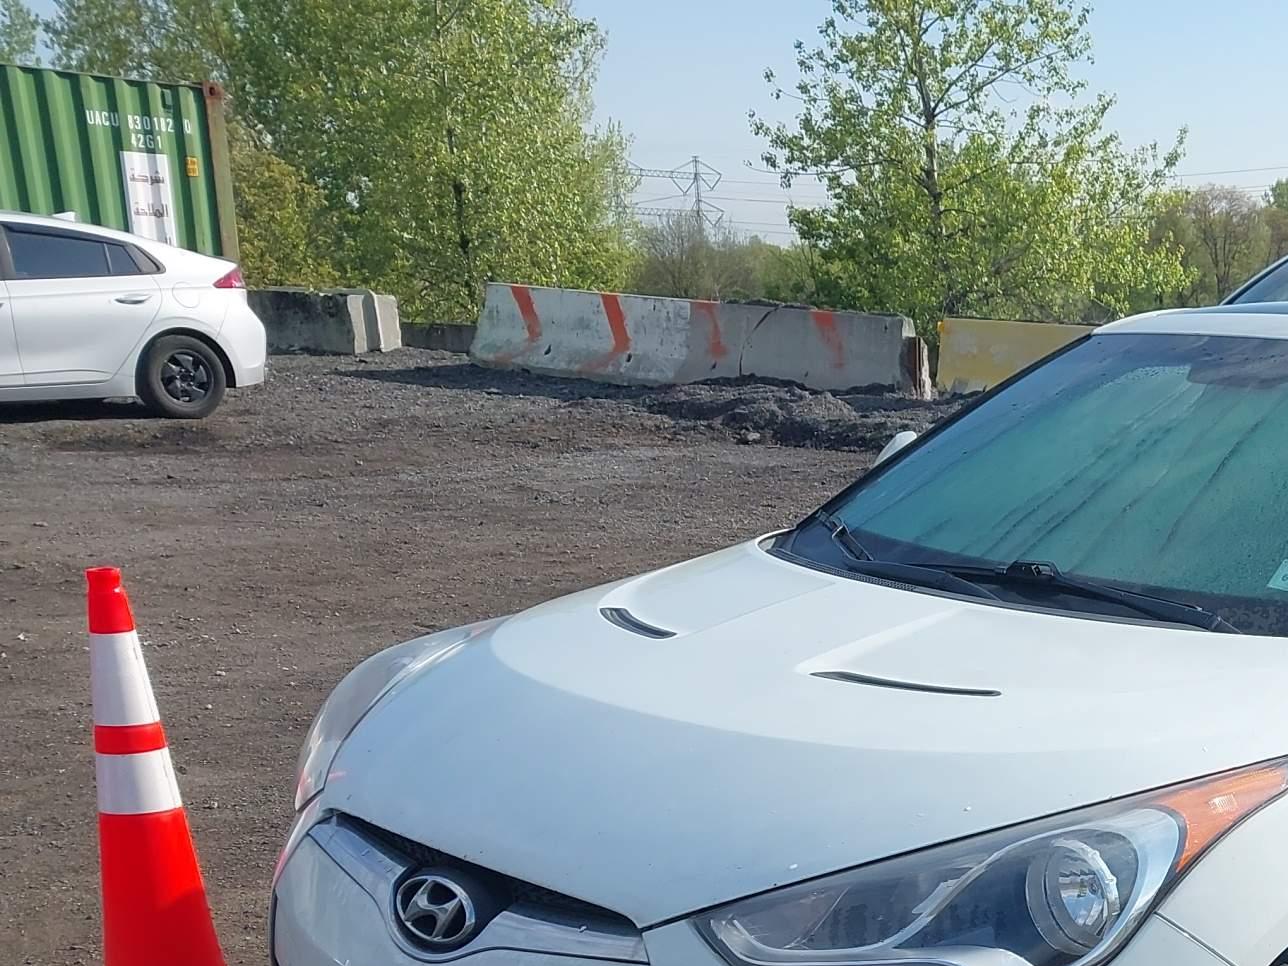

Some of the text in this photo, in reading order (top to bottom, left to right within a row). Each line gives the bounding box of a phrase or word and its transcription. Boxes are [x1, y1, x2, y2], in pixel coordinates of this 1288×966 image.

[85, 109, 119, 127] UACU
[127, 114, 175, 133] 830182
[131, 133, 162, 149] 42G1
